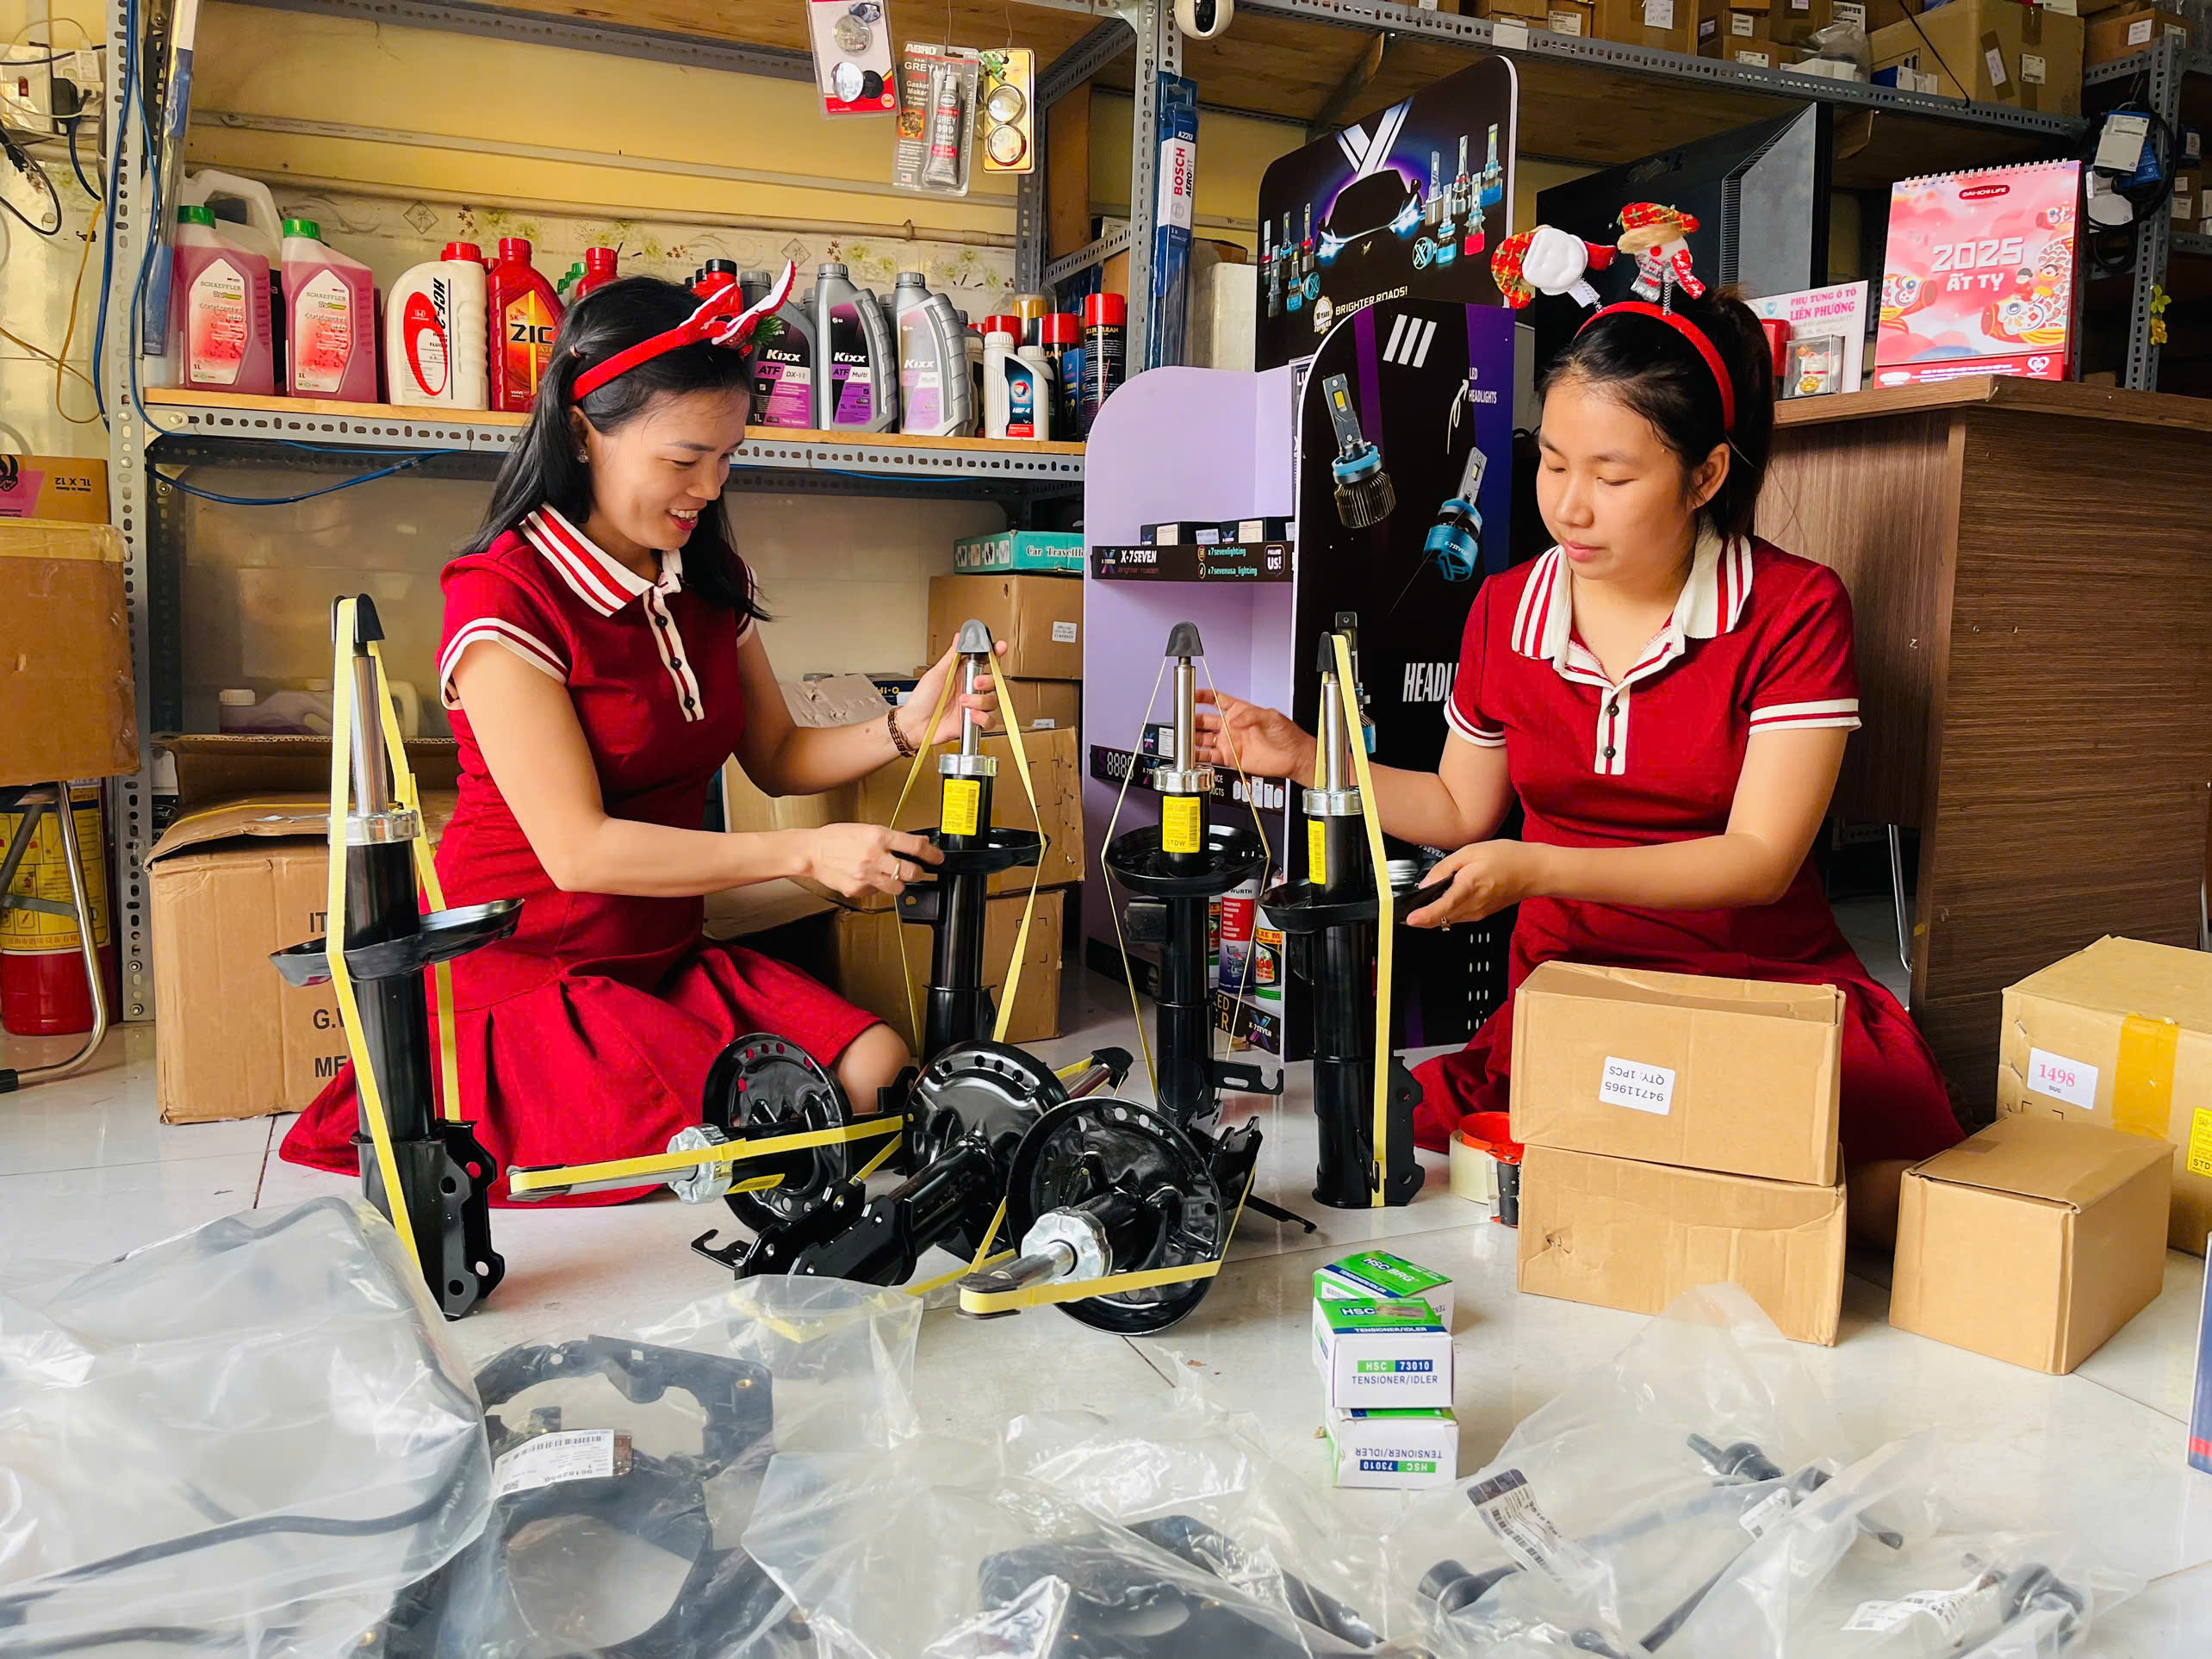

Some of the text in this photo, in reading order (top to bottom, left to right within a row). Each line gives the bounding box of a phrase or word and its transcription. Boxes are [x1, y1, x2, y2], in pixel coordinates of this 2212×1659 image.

[905, 43, 937, 56] ABRO
[904, 61, 934, 72] GREY
[906, 80, 930, 89] Gasket
[907, 87, 928, 96] Maker
[936, 115, 957, 126] GREY
[936, 125, 954, 134] 999
[1174, 147, 1185, 196] BOSCH
[1185, 158, 1194, 199] AEROFIT
[1991, 186, 2007, 195] LIFE
[1930, 237, 2025, 274] 2025
[432, 276, 446, 330] HCF-2
[1335, 285, 1408, 316] BRIGHTER ROADS!
[1790, 301, 1855, 321] LIÊN PHƯƠNG
[510, 323, 555, 345] ZIC
[766, 349, 802, 363] Kixx
[834, 351, 867, 363] Kixx
[904, 358, 935, 369] Kixx
[758, 364, 781, 376] ATF
[832, 368, 850, 376] ATF
[851, 370, 868, 379] Multi
[1469, 389, 1497, 405] HEADLIGHTS
[1027, 544, 1043, 556] Car
[1267, 556, 1282, 570] US!
[1609, 1066, 1665, 1085] QTY: 1PCS
[2039, 1064, 2076, 1088] 1498
[1605, 1081, 1664, 1102] 94711965
[2192, 1159, 2211, 1171] STD
[1364, 1258, 1415, 1283] HSC BRG
[1340, 1307, 1377, 1315] HSC
[1366, 1361, 1430, 1371] HSC 73010
[1351, 1375, 1438, 1386] TENSIONER/IDLER
[1355, 1447, 1444, 1459] TENSIONER/IDLER
[1363, 1461, 1427, 1472] HSC 73010
